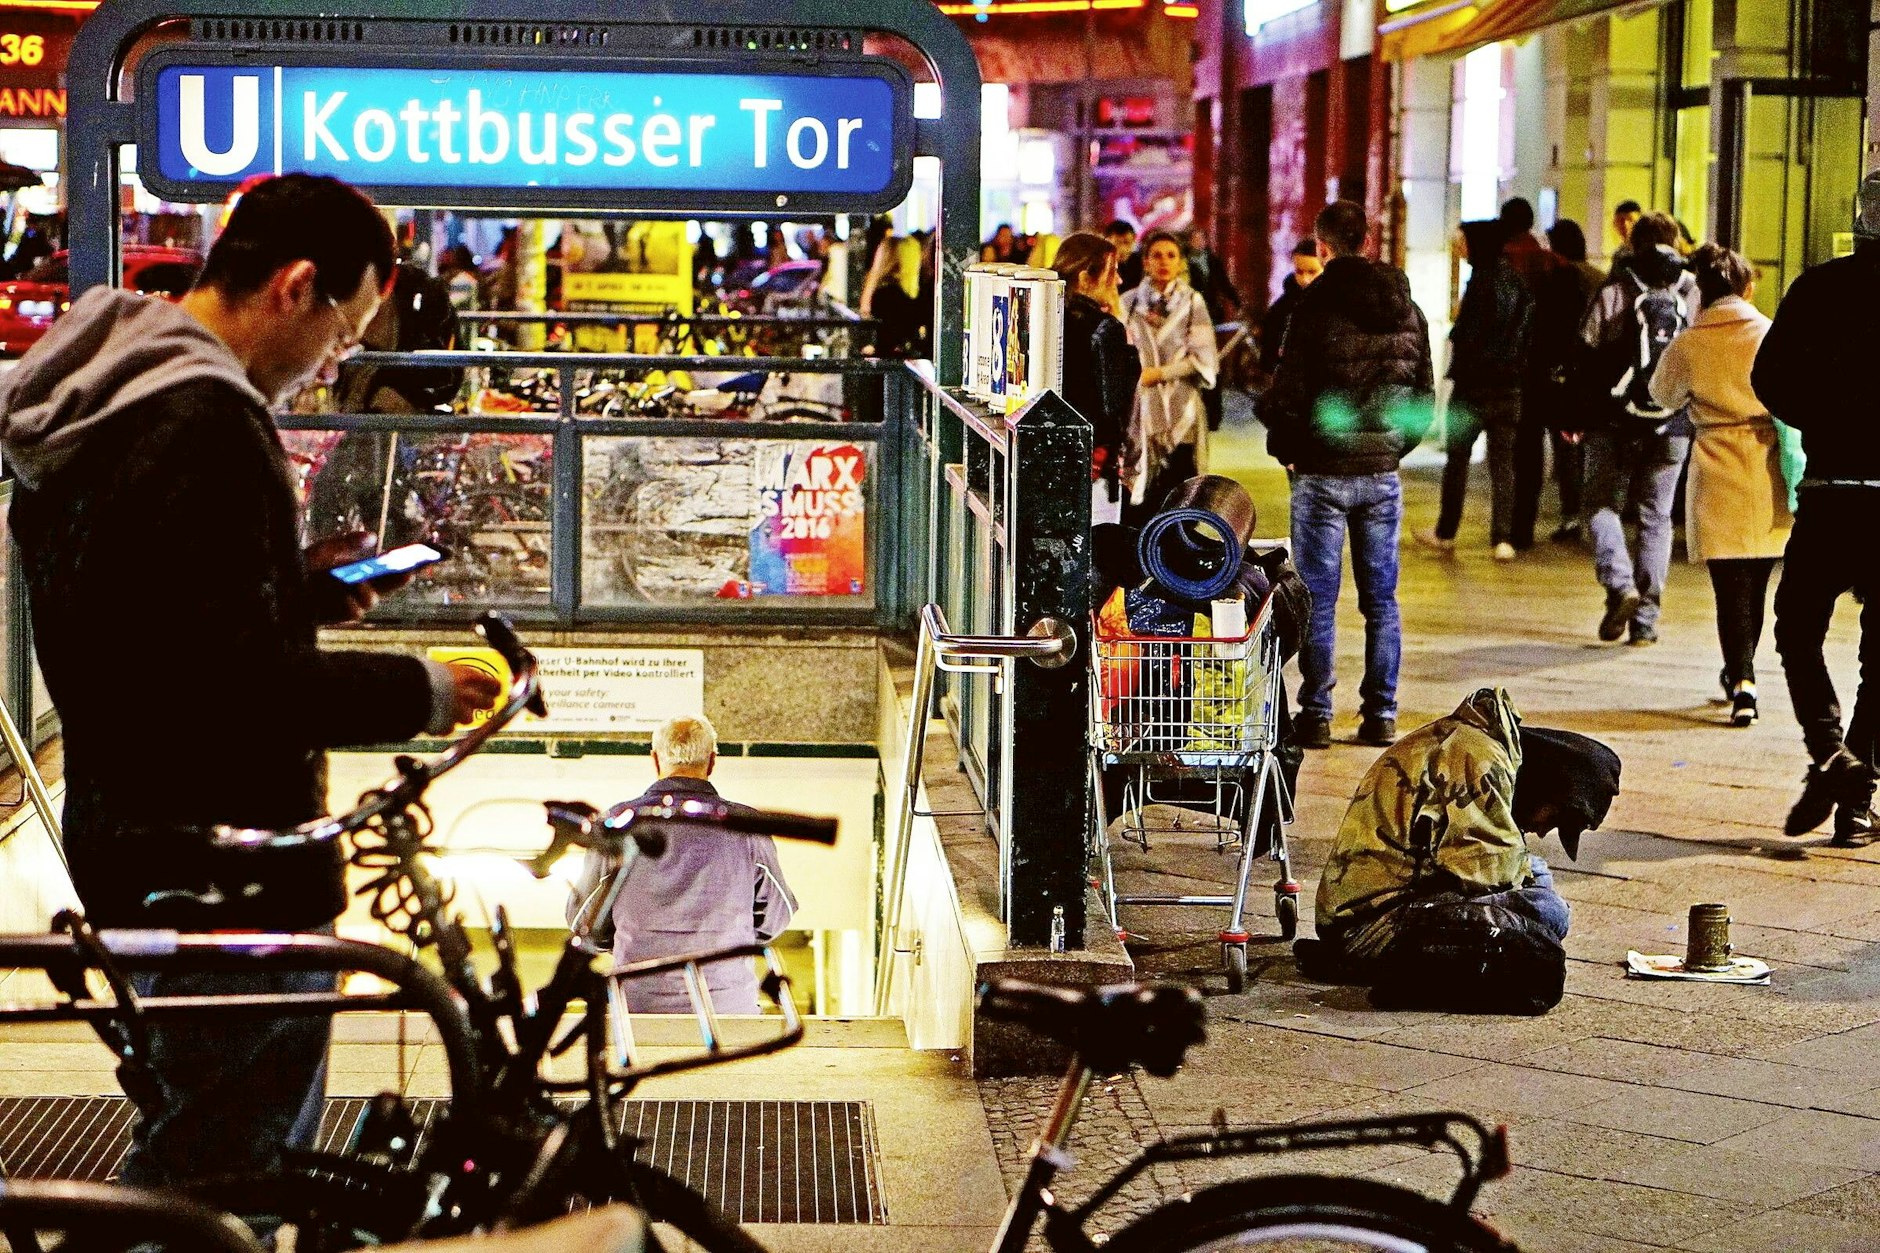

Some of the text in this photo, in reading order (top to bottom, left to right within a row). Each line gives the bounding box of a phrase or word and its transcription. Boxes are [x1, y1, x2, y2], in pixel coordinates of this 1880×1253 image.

[180, 75, 259, 176] U
[303, 88, 715, 168] Kottbusser
[739, 98, 863, 169] Tor
[755, 449, 860, 491] MARX
[781, 490, 862, 518] MUSS
[780, 516, 832, 539] 2016
[536, 656, 561, 666] ieser
[564, 656, 619, 667] U-Bahnhof
[622, 656, 645, 667] wird
[648, 659, 659, 667] zu
[537, 667, 580, 677] cherheit
[583, 669, 600, 679] per
[604, 667, 632, 678] Video
